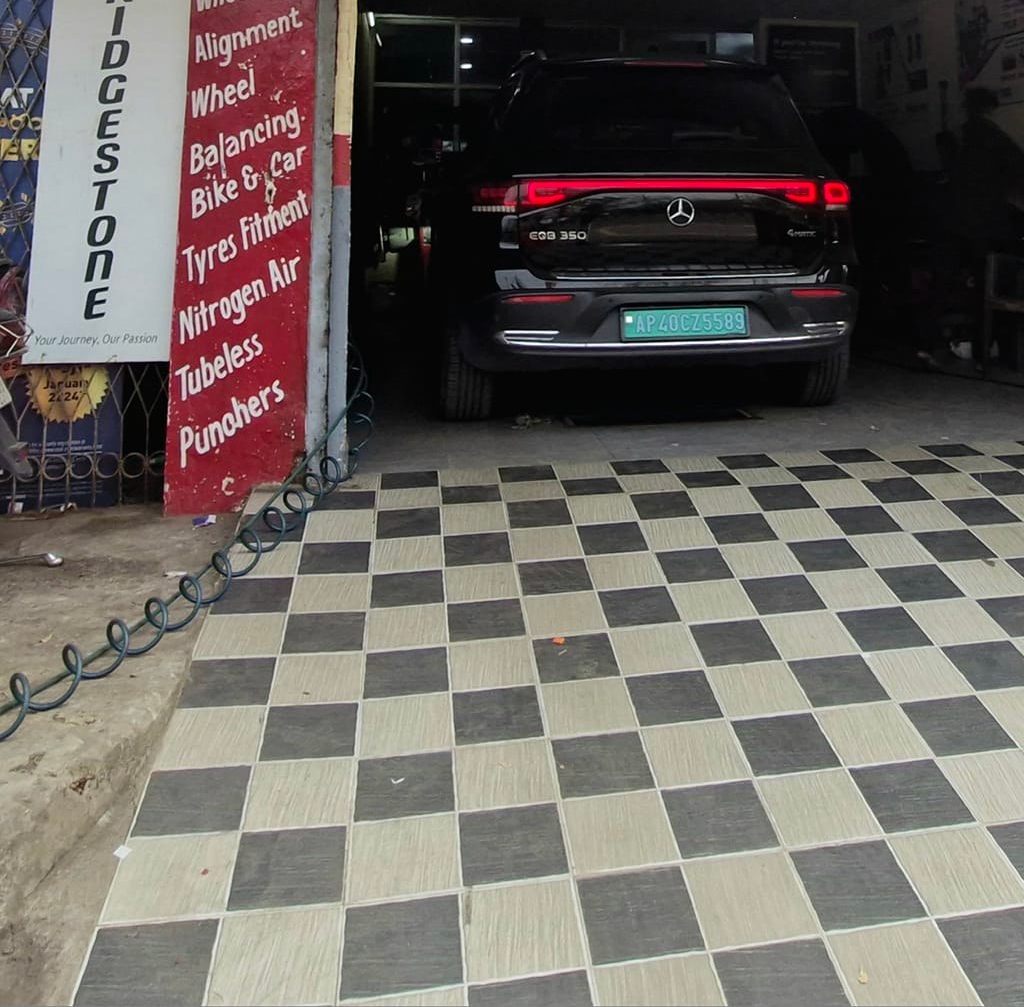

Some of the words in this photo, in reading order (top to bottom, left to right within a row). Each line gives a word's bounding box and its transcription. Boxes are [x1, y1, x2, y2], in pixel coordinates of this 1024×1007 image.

[195, 6, 304, 67] Alignment
[191, 68, 256, 119] Wheel
[189, 106, 301, 179] Balancing
[191, 179, 239, 220] Bike
[241, 164, 260, 191] &
[270, 146, 307, 178] Car
[182, 234, 238, 285] Tyres
[239, 189, 310, 251] Fitment
[529, 231, 556, 241] EQB
[560, 231, 587, 241] 350
[179, 278, 267, 345] Nitrogen
[268, 256, 301, 293] Air
[636, 312, 745, 334] AP40CZ5589
[34, 335, 56, 346] Your
[58, 334, 100, 347] Journey,
[102, 334, 121, 345] Our
[122, 333, 158, 344] Passion
[175, 333, 264, 401] Tubeless
